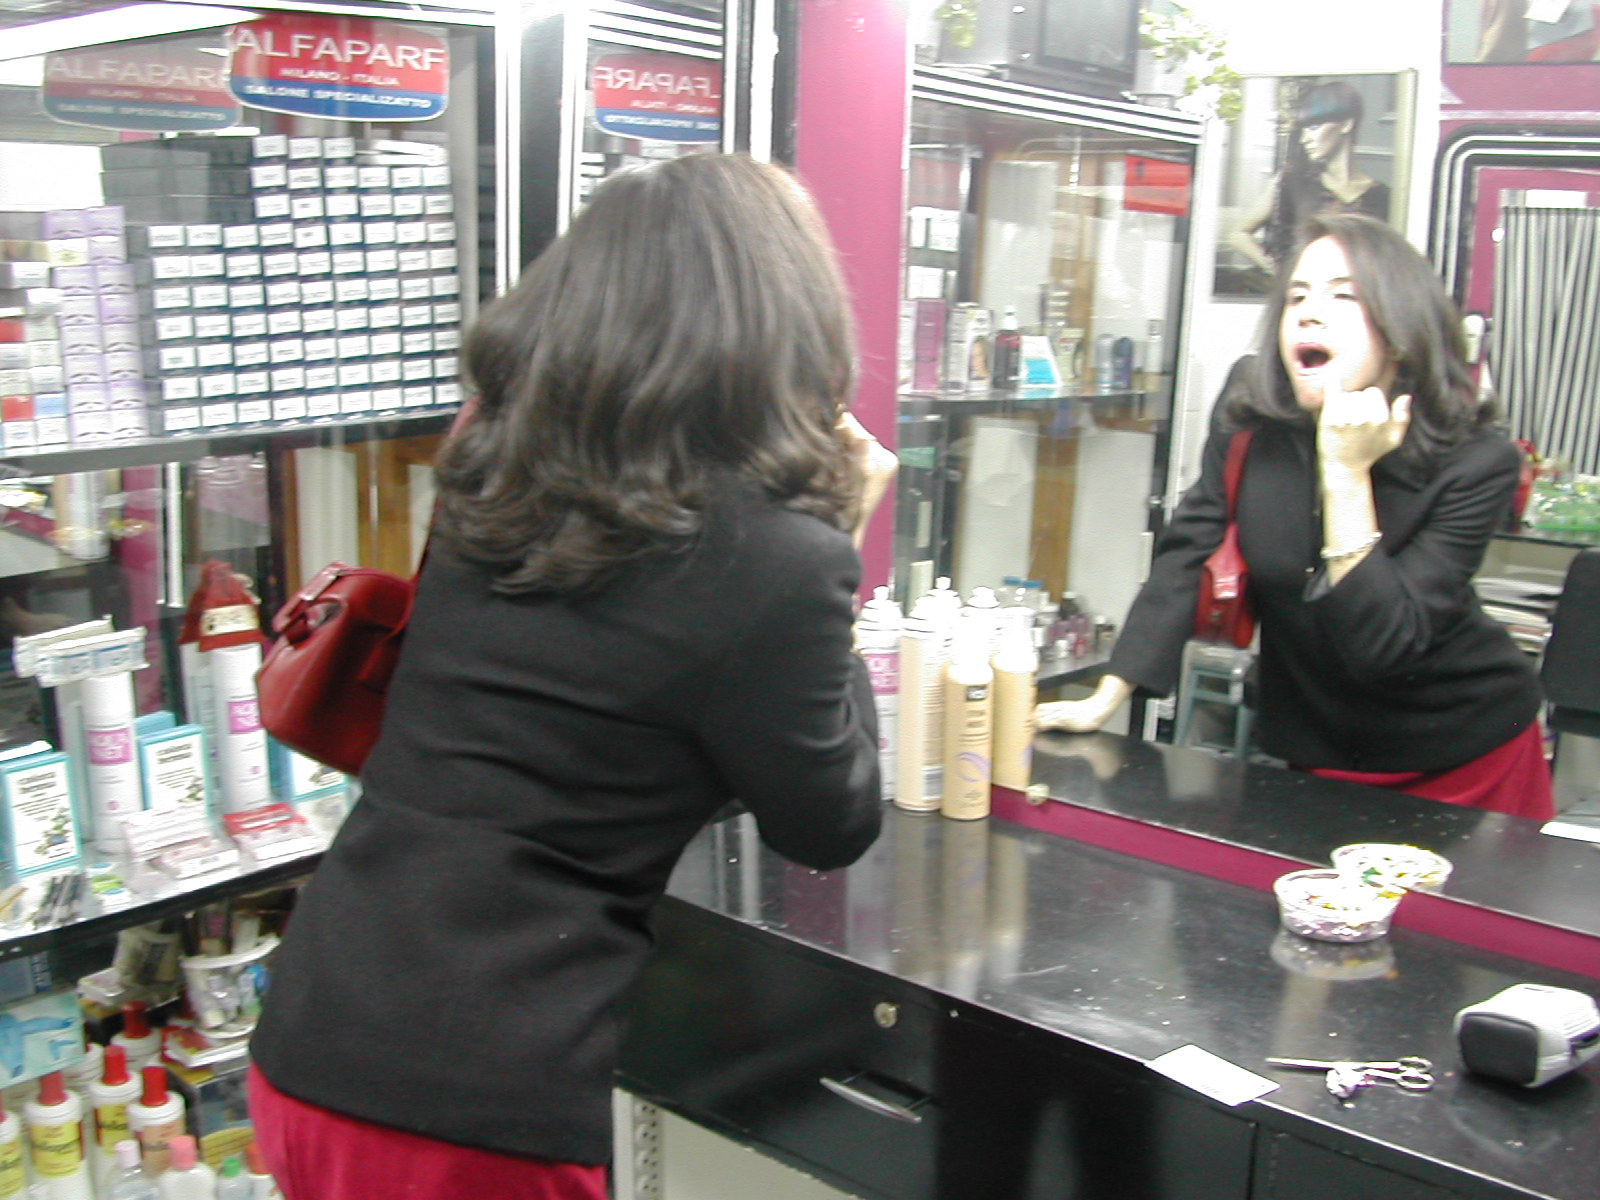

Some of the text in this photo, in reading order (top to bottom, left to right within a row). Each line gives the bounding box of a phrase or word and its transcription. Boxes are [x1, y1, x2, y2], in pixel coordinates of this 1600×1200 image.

[235, 28, 446, 71] ALFAPARF
[280, 68, 341, 82] MILANO
[352, 73, 400, 86] ITALIA
[244, 85, 310, 99] SALONE
